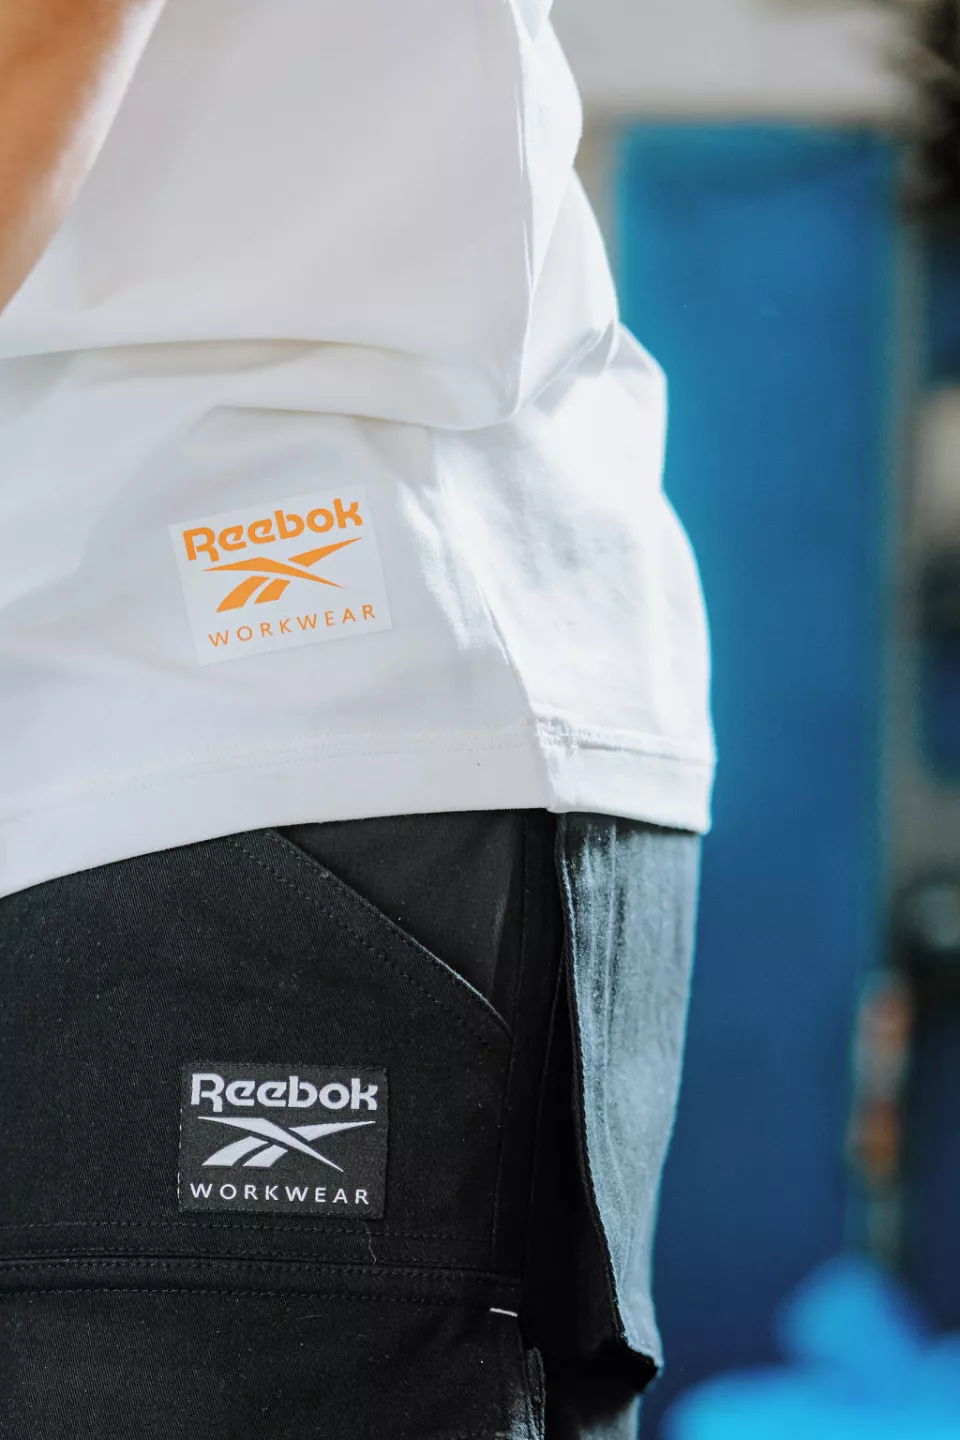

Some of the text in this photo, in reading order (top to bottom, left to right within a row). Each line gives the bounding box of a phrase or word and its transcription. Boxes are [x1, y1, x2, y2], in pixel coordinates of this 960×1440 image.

[182, 498, 363, 562] Reebok
[208, 604, 376, 647] WORKWEAR
[190, 1073, 378, 1113] Reebok
[190, 1183, 369, 1205] WORKWEAR
